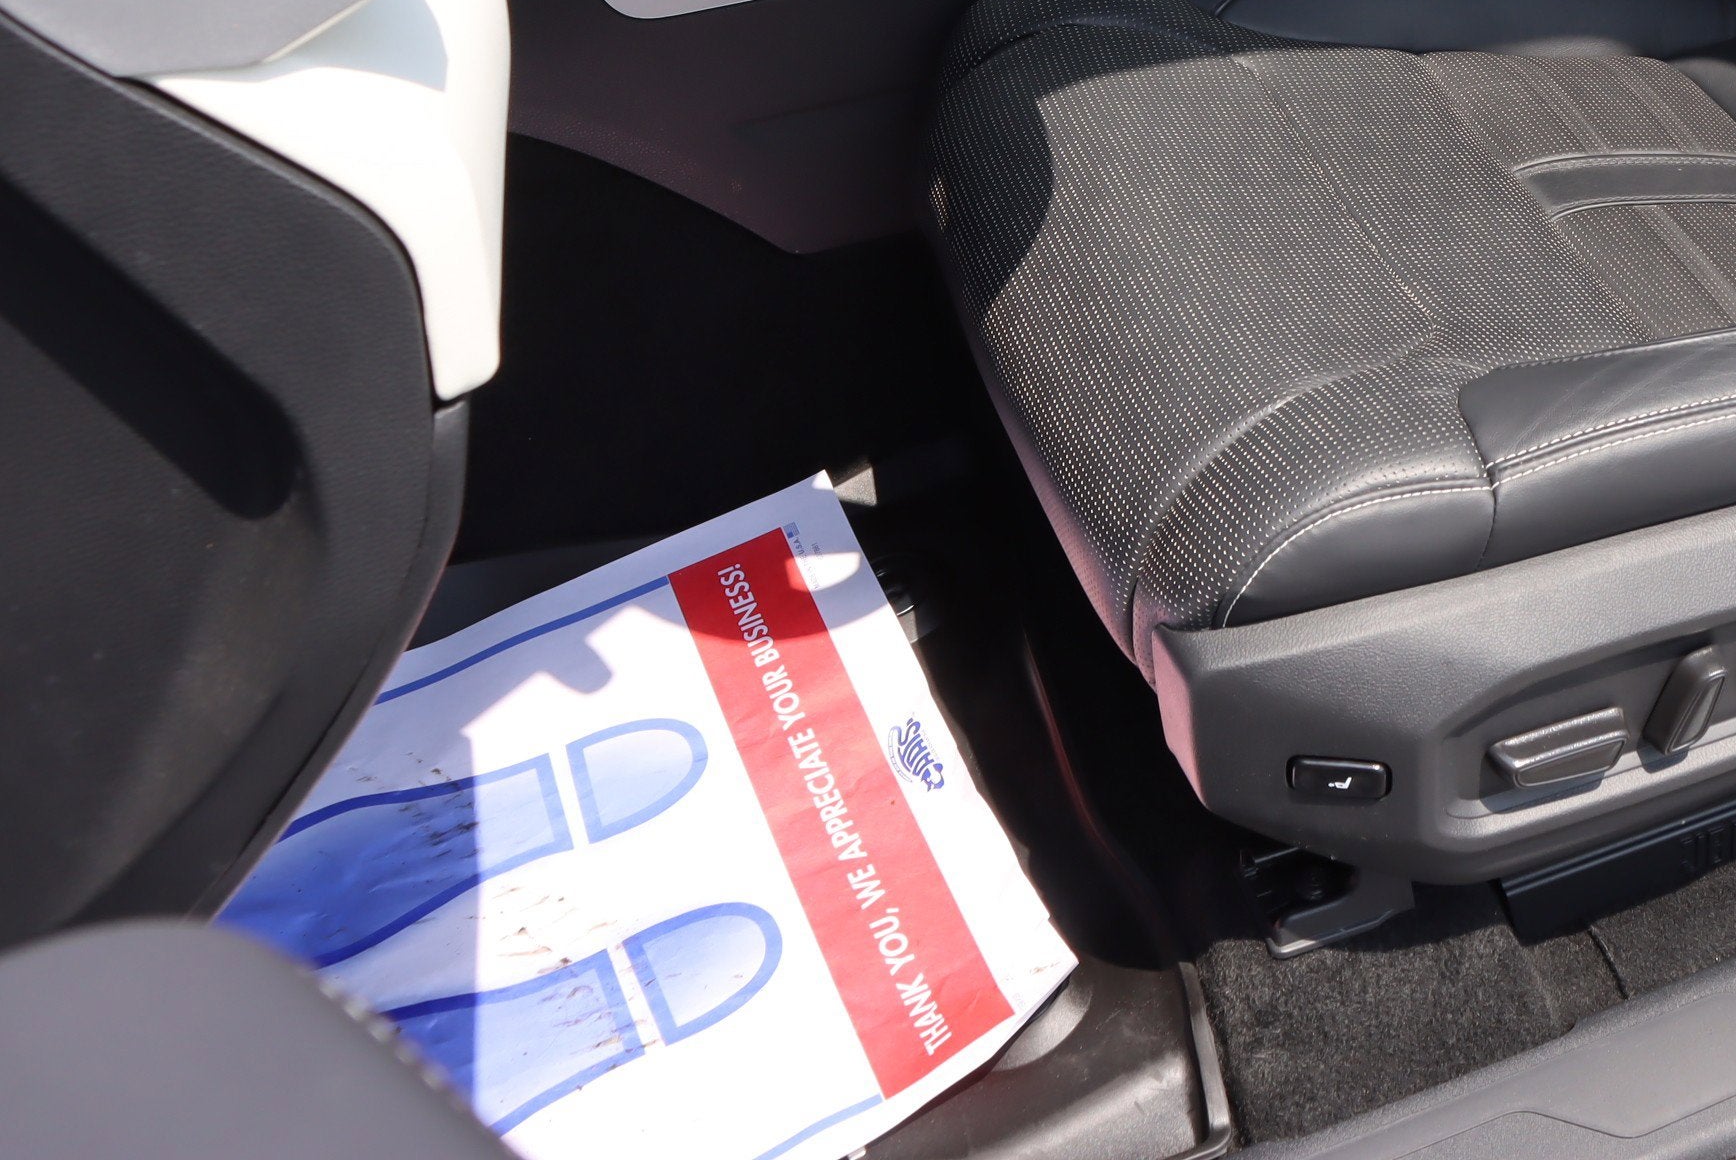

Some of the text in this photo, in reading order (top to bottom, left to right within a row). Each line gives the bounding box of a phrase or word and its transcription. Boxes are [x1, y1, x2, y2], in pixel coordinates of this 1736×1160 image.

[718, 564, 951, 1055] THANK YOU, WE APPRECIATE YOUR BUSINESS!
